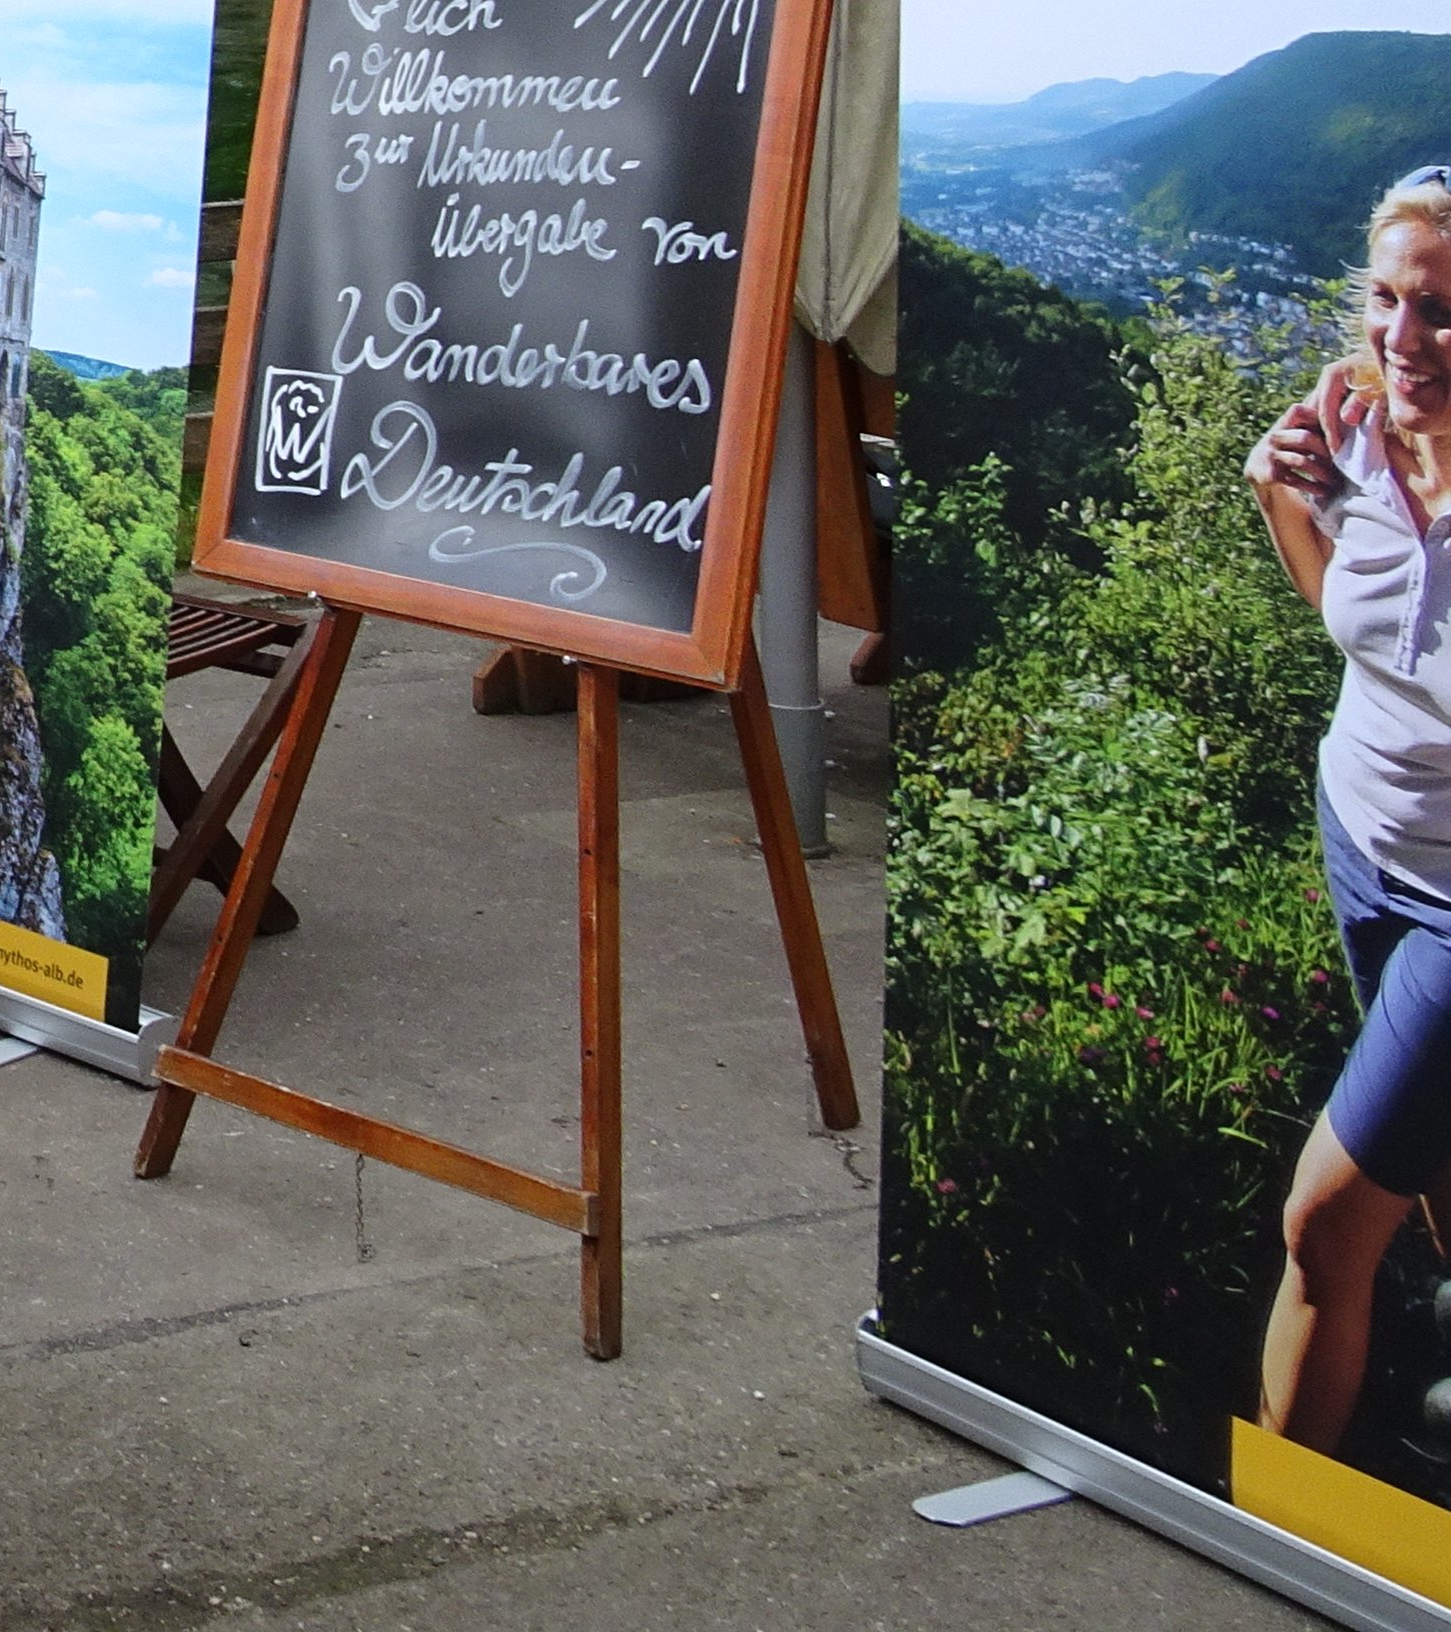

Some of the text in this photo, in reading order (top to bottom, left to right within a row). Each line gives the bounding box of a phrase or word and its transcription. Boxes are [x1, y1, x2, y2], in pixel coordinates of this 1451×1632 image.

[329, 42, 620, 117] Willkommen
[431, 193, 617, 296] Übergabe
[331, 280, 712, 413] Wanderbares
[340, 400, 710, 553] Deutschland
